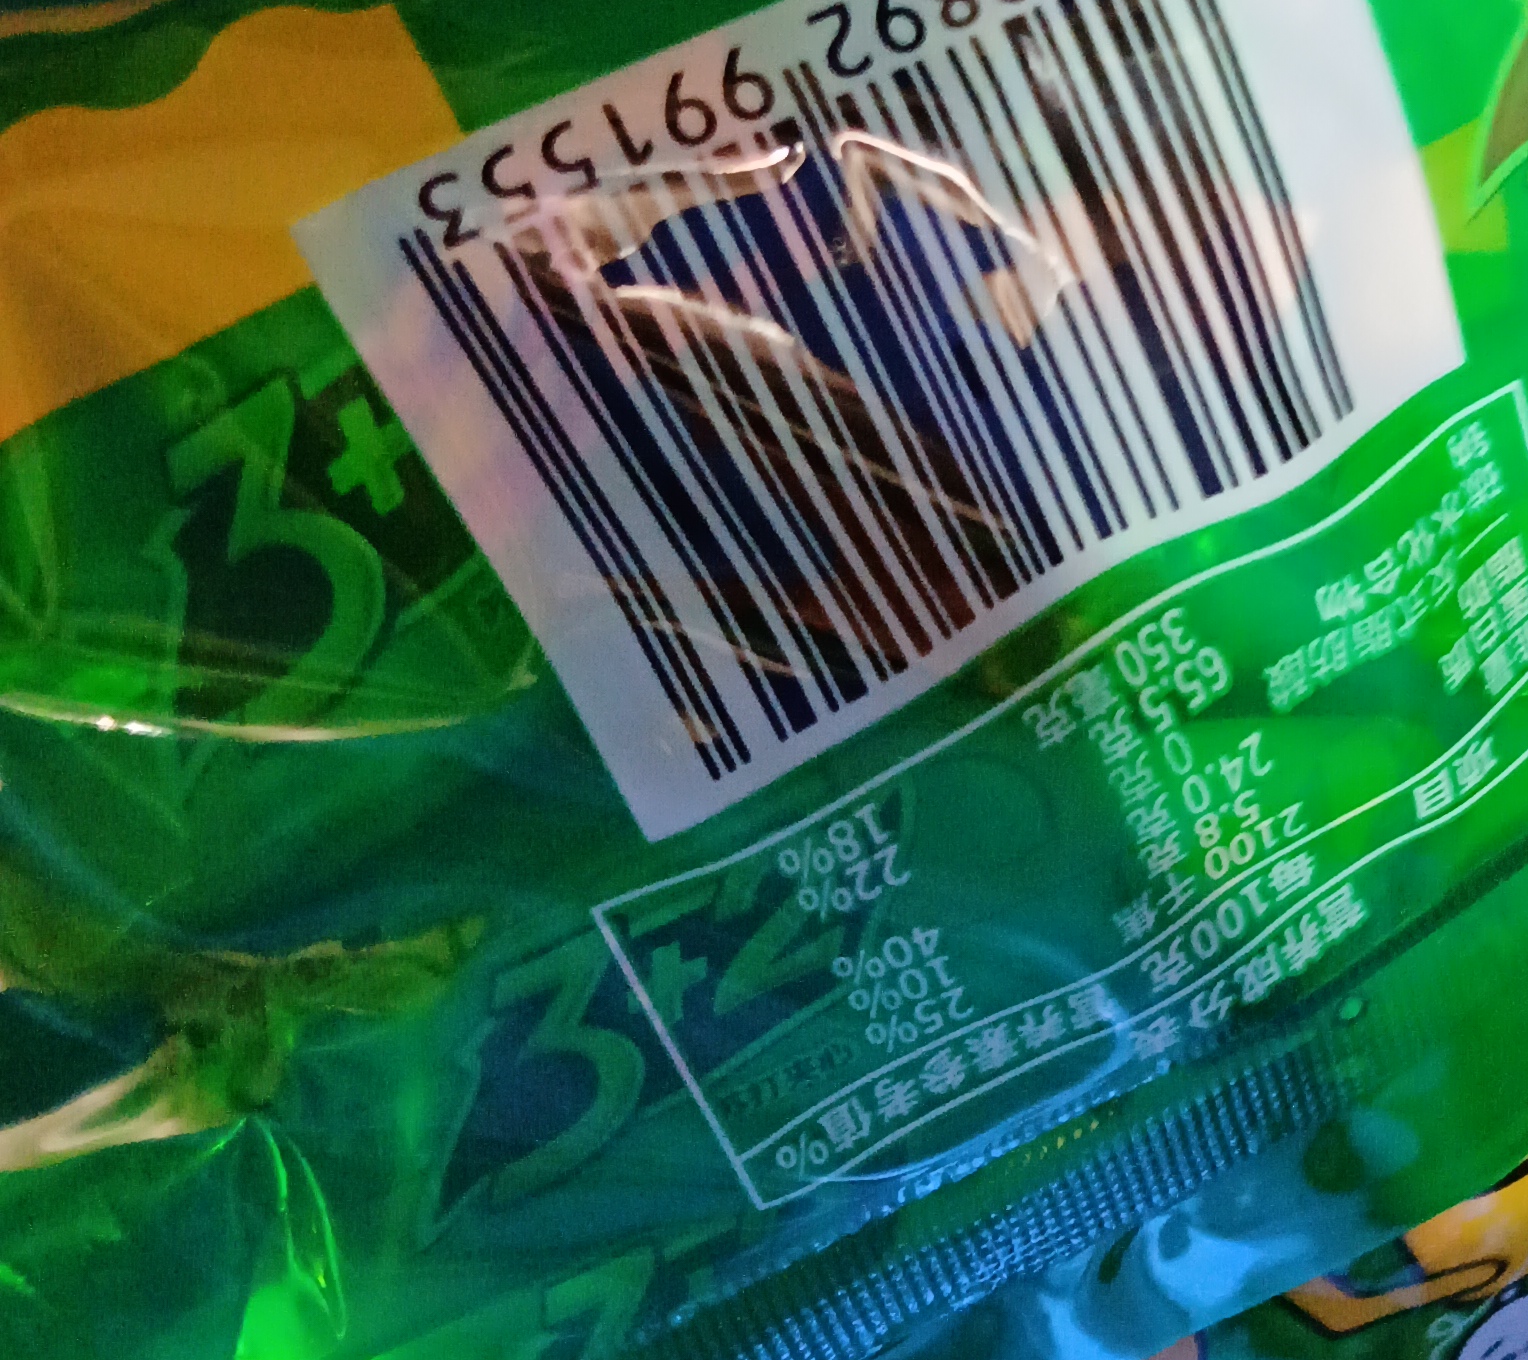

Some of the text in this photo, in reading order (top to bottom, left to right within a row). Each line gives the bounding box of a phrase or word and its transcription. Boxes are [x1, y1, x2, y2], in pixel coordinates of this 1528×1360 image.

[416, 46, 776, 251] 991553
[1315, 464, 1500, 617] 碳水化合物
[1024, 609, 1192, 746] 350 毫克
[1089, 646, 1229, 762] 65.5 克
[1109, 731, 1192, 804] 0 克
[1126, 735, 1269, 844] 24.0 克
[1413, 739, 1494, 816] 项目
[777, 806, 884, 882] 18%
[796, 847, 908, 918] 22%
[1113, 804, 1305, 940] 2100 千焦
[1138, 792, 1259, 876] 5.8 克
[832, 924, 941, 986] 40%
[1131, 886, 1365, 1057] 营养成分表
[1139, 852, 1316, 993] 每100克
[847, 958, 952, 1018] 10%
[865, 989, 971, 1048] 25%
[775, 987, 1110, 1174] 营养素参考值%
